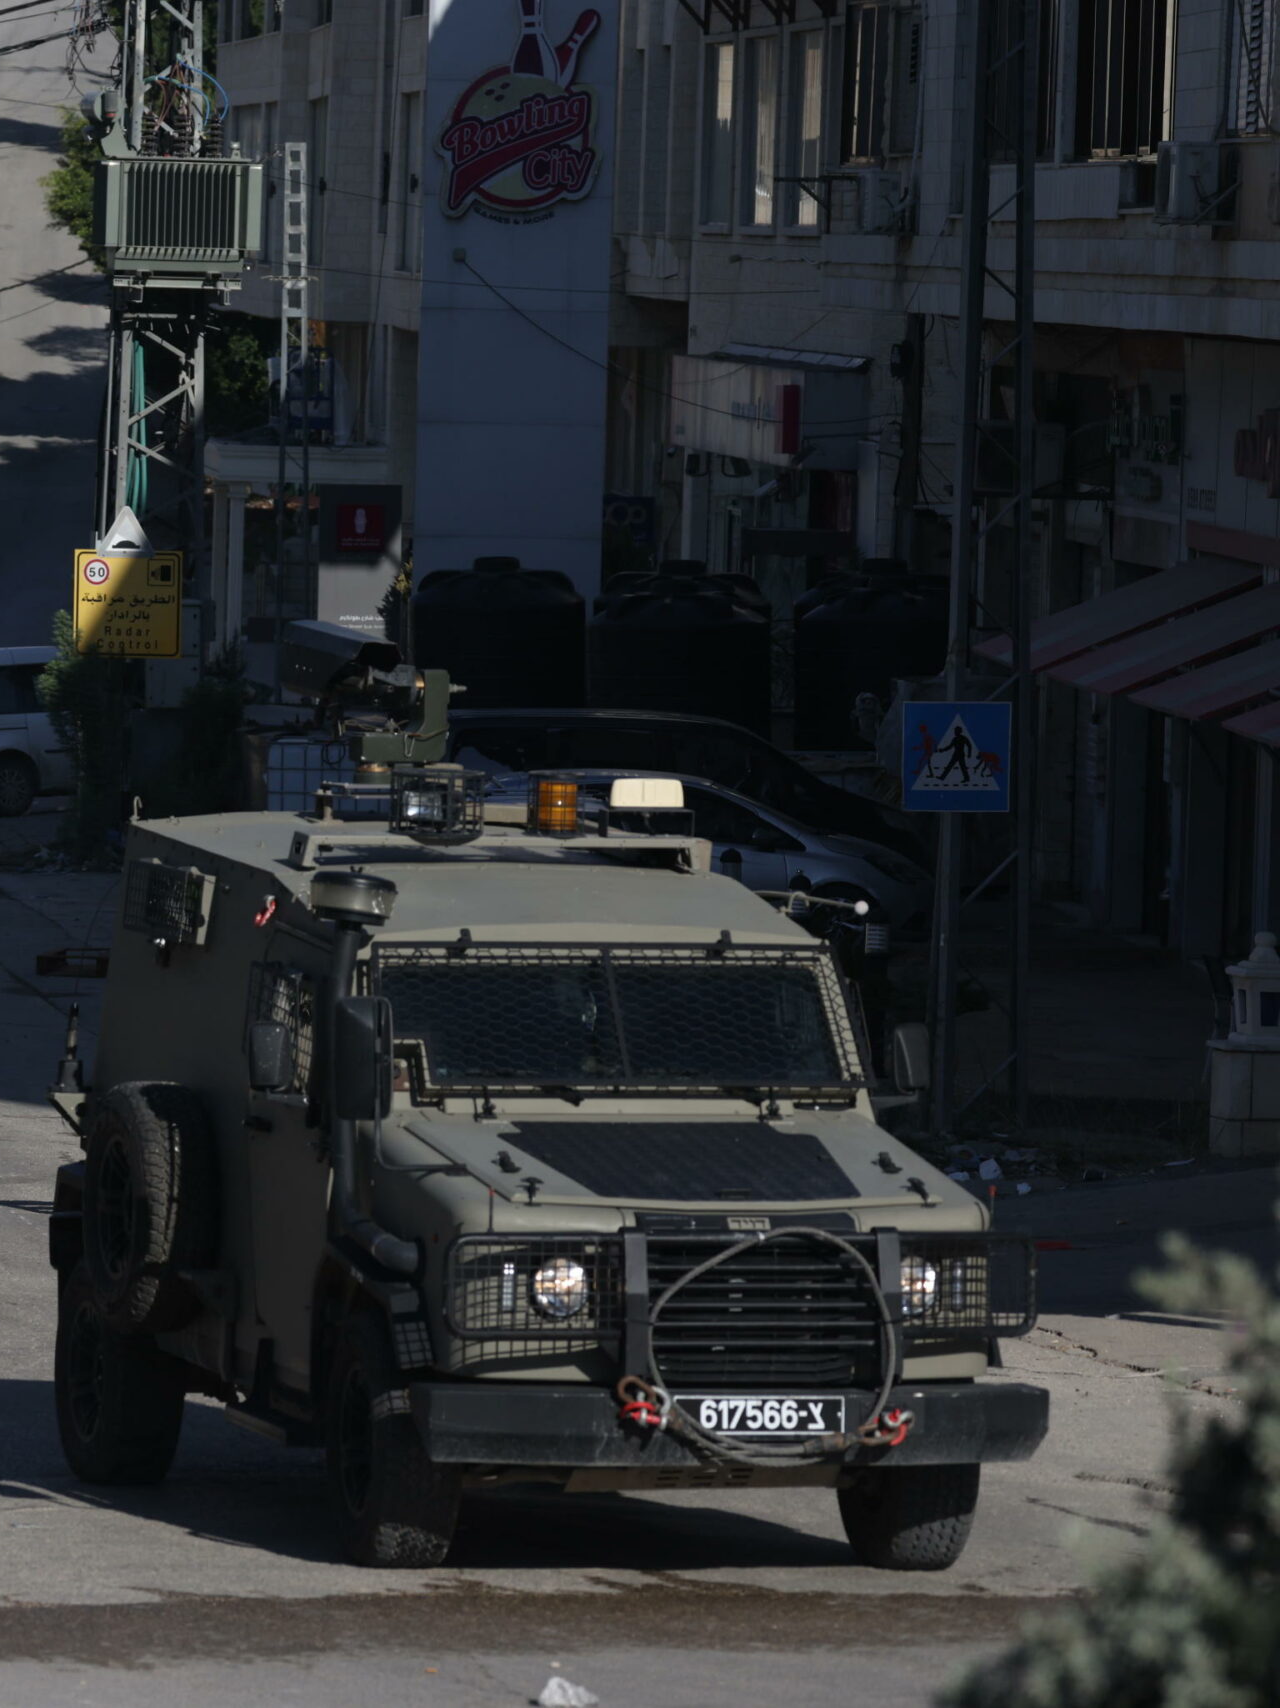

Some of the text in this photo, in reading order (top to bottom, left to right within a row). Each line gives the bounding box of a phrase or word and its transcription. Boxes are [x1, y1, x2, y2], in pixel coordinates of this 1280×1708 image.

[442, 95, 589, 165] Bowling
[524, 146, 595, 191] City
[89, 567, 105, 578] 50
[105, 626, 151, 636] Radar
[96, 639, 158, 649] Control
